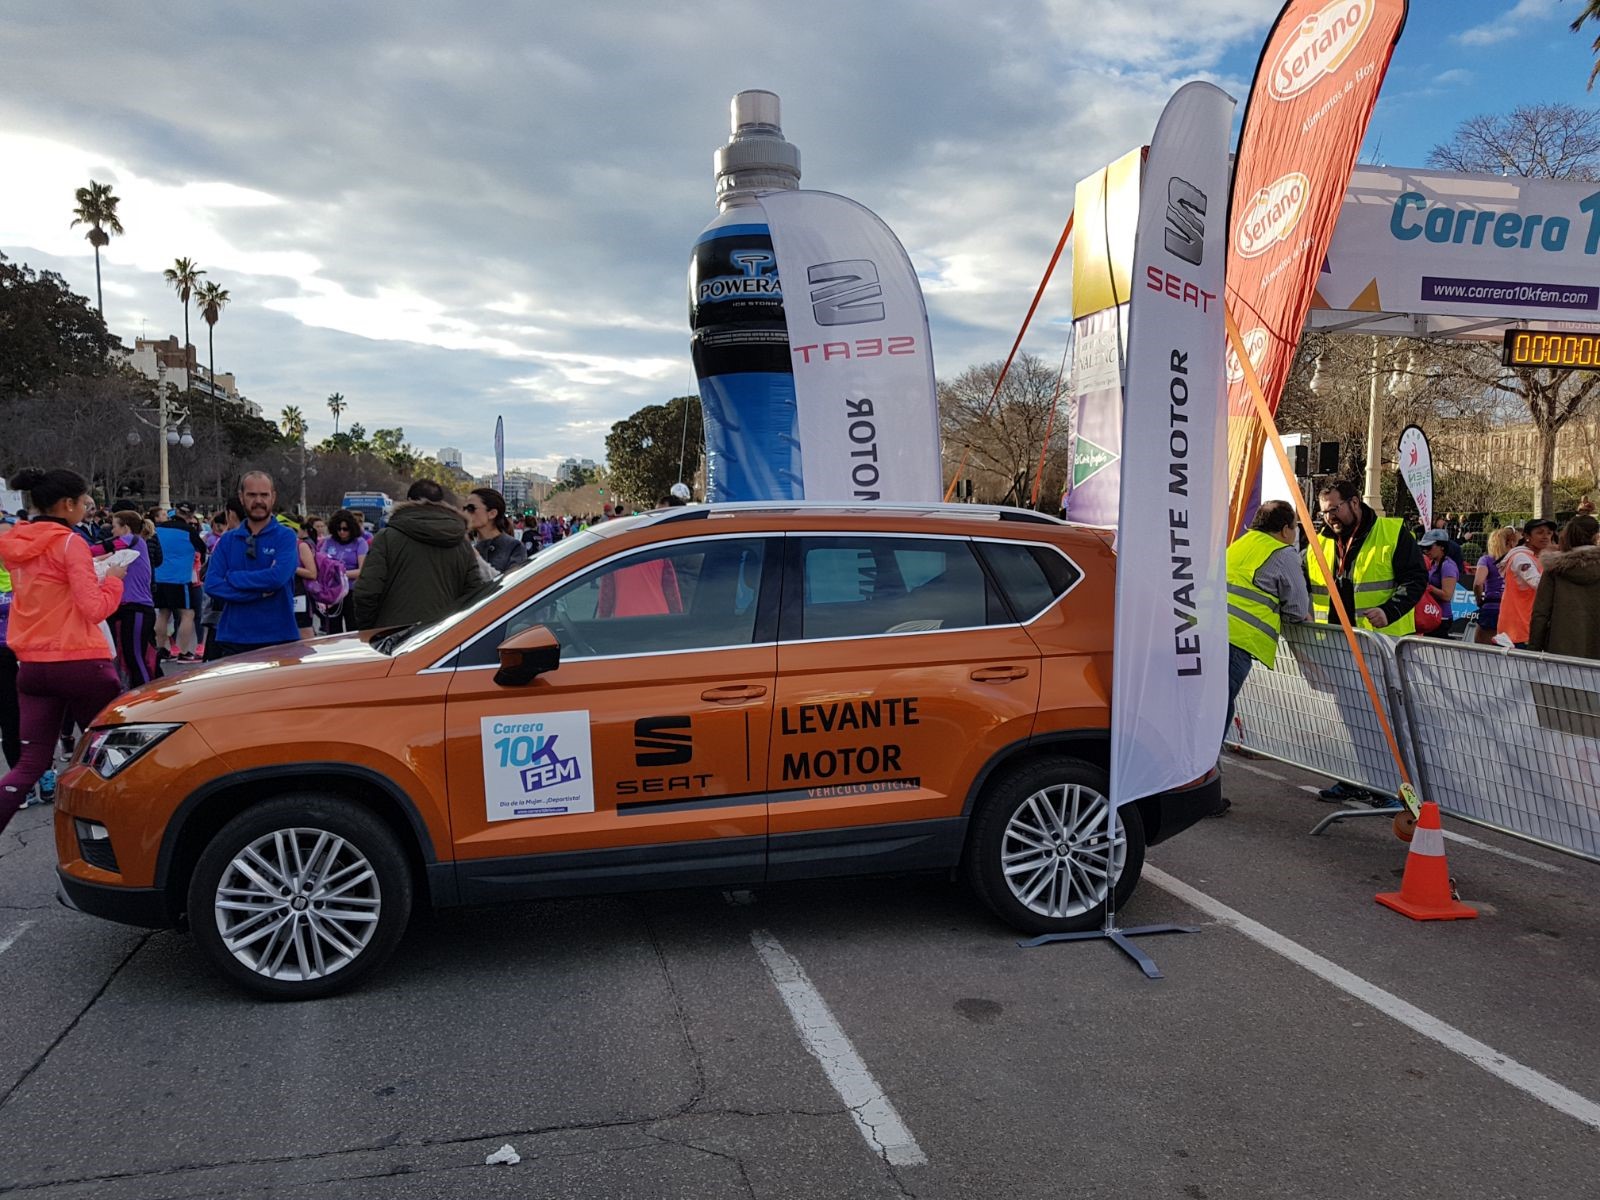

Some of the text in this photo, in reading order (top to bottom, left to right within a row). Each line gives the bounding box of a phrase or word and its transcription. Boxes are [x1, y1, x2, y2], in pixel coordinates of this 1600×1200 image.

[1280, 4, 1361, 89] Serrano
[1302, 90, 1343, 135] Alimentos
[1355, 61, 1375, 83] Hoy
[1243, 185, 1300, 249] Serrano
[1390, 191, 1570, 252] Carrera
[1146, 265, 1216, 313] SEAT
[1433, 284, 1588, 304] www.carrera10kfem.com
[1168, 349, 1202, 677] LEVANTE MOTOR
[493, 723, 544, 735] Carrera
[781, 697, 920, 735] LEVANTE
[494, 735, 559, 768] 10K
[782, 744, 902, 781] MOTOR
[525, 759, 576, 790] FEM
[616, 773, 713, 795] SEAT
[872, 779, 919, 792] OFICIAL
